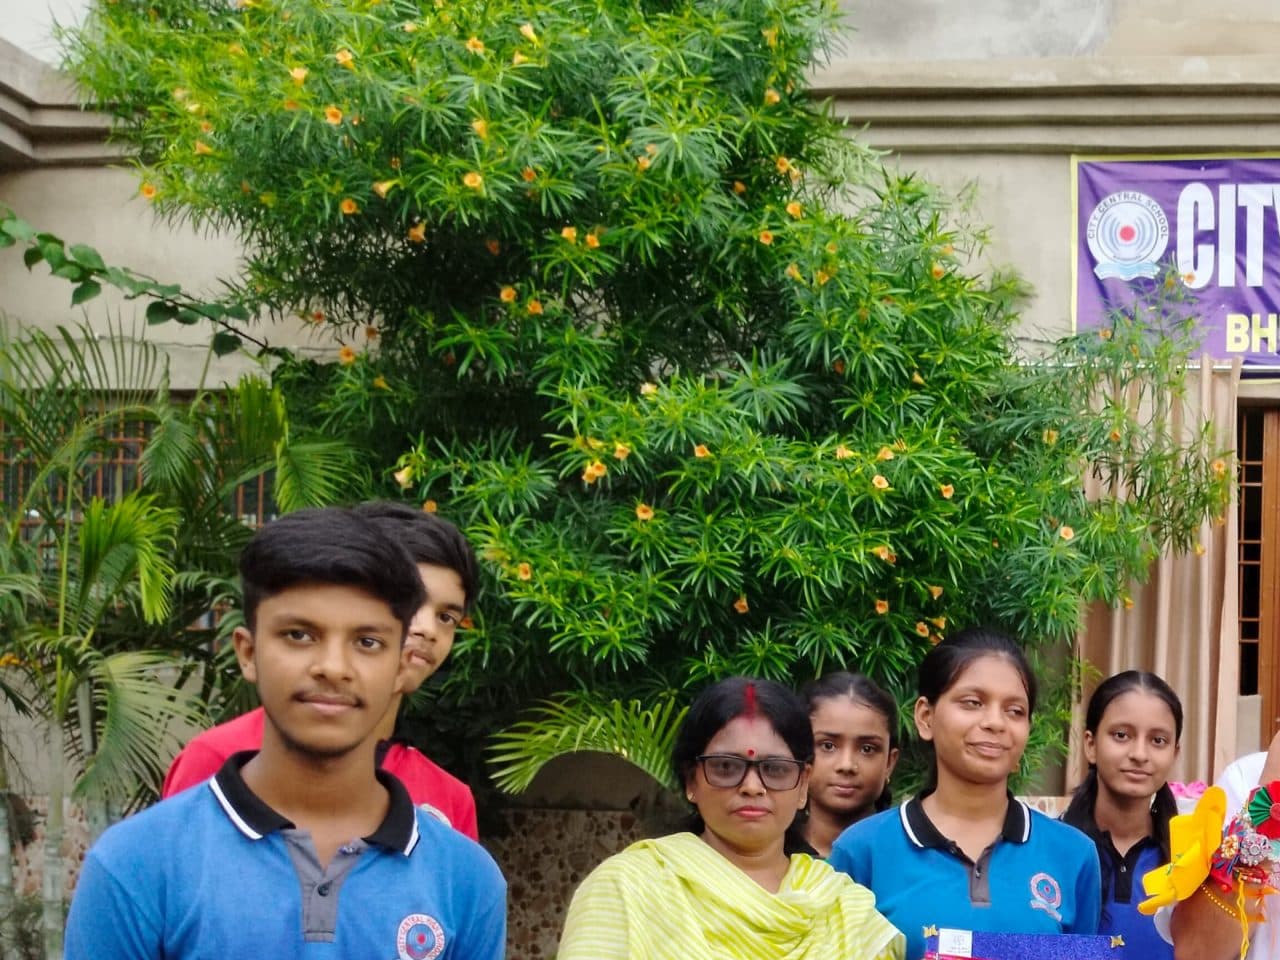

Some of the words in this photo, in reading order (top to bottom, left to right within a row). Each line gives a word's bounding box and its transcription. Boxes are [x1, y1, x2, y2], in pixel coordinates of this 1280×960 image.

[1087, 216, 1098, 239] CITY
[1098, 192, 1143, 213] CENTRAL
[1146, 199, 1169, 240] SCHOOL
